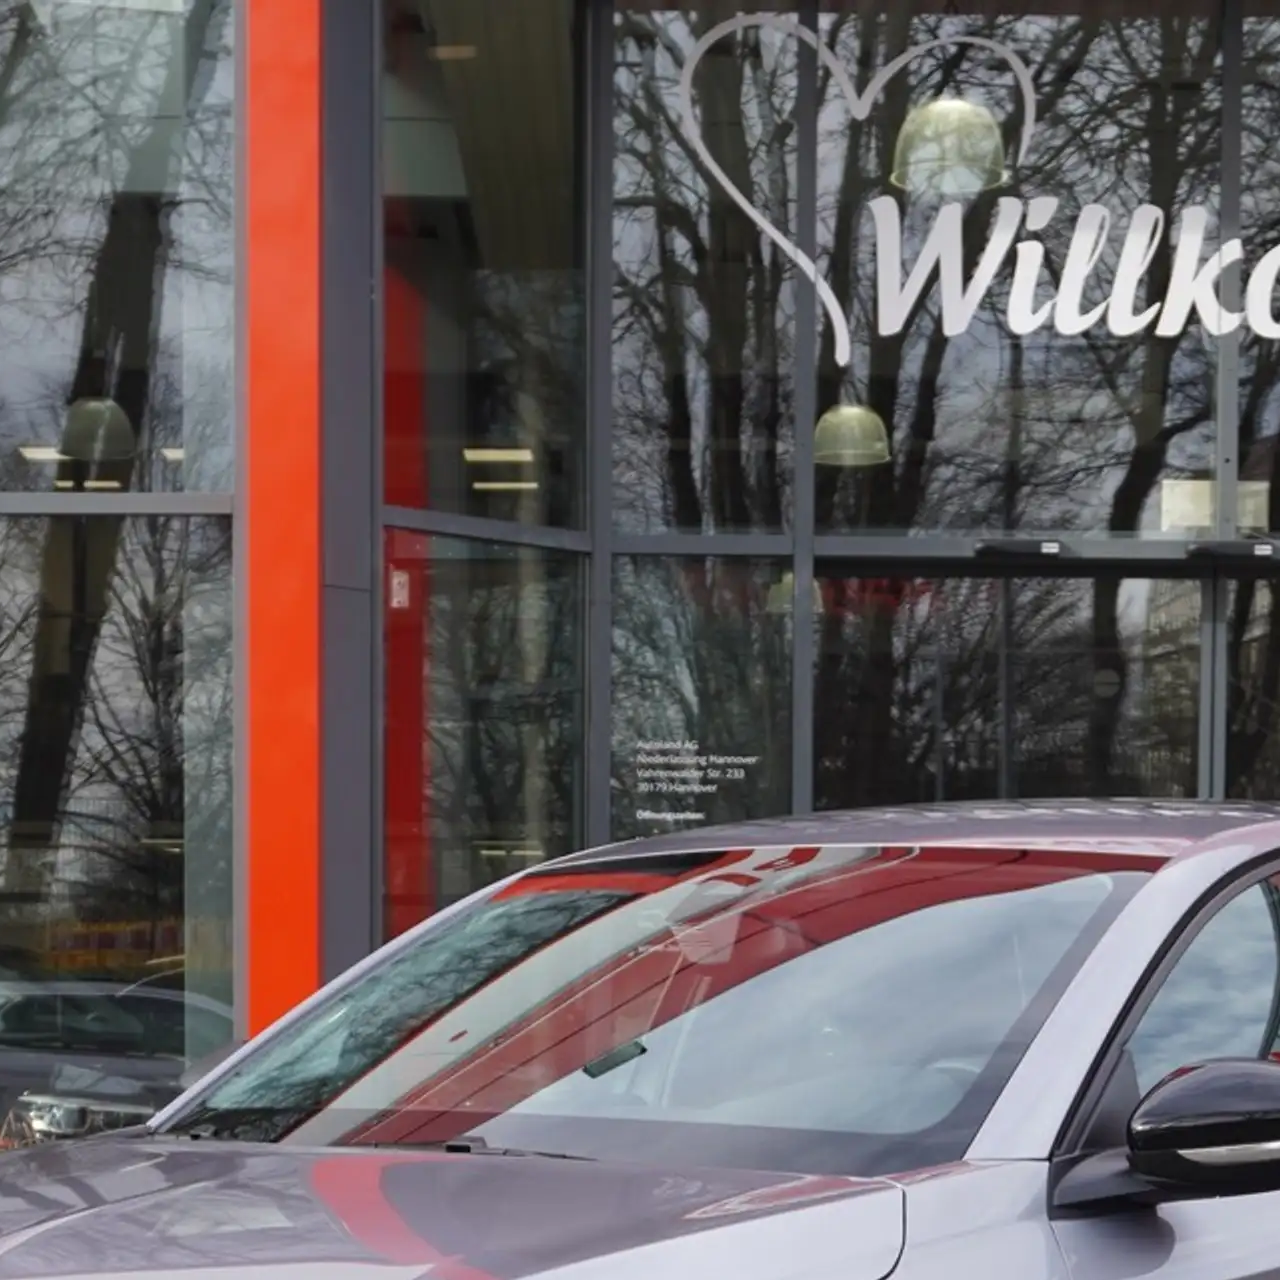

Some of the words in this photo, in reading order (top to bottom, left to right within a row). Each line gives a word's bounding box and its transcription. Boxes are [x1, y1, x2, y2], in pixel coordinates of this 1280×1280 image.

[683, 740, 699, 750] AG
[709, 754, 759, 764] Hannover
[669, 783, 718, 793] Hannover
